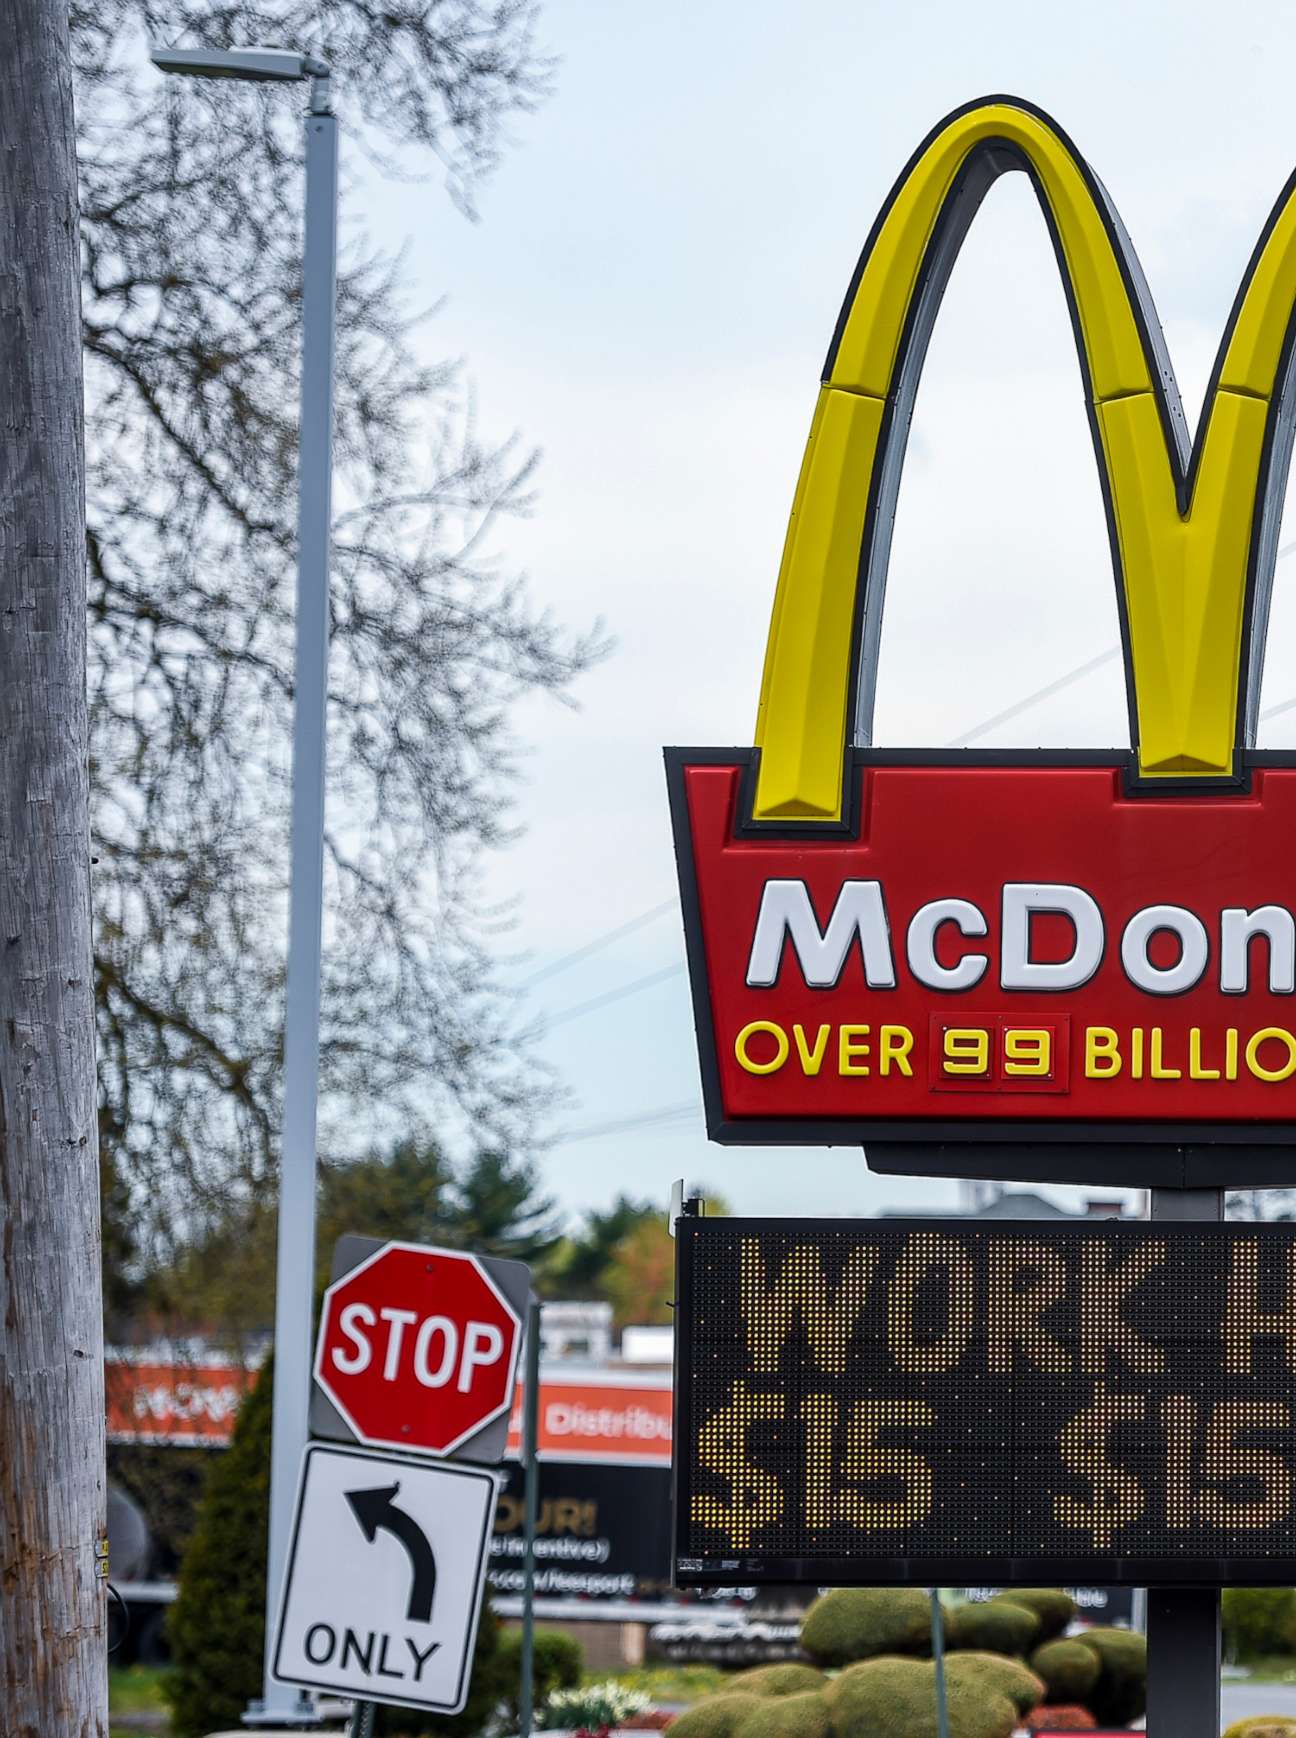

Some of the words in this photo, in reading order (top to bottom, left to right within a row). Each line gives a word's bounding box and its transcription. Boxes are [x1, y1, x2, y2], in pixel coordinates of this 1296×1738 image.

[734, 1020, 915, 1078] OVER
[943, 1028, 1051, 1076] 99
[331, 1302, 505, 1394] STOP
[739, 1233, 1166, 1374] WORK
[689, 1379, 937, 1549] $15
[1052, 1380, 1292, 1549] $15
[305, 1624, 440, 1682] ONLY
